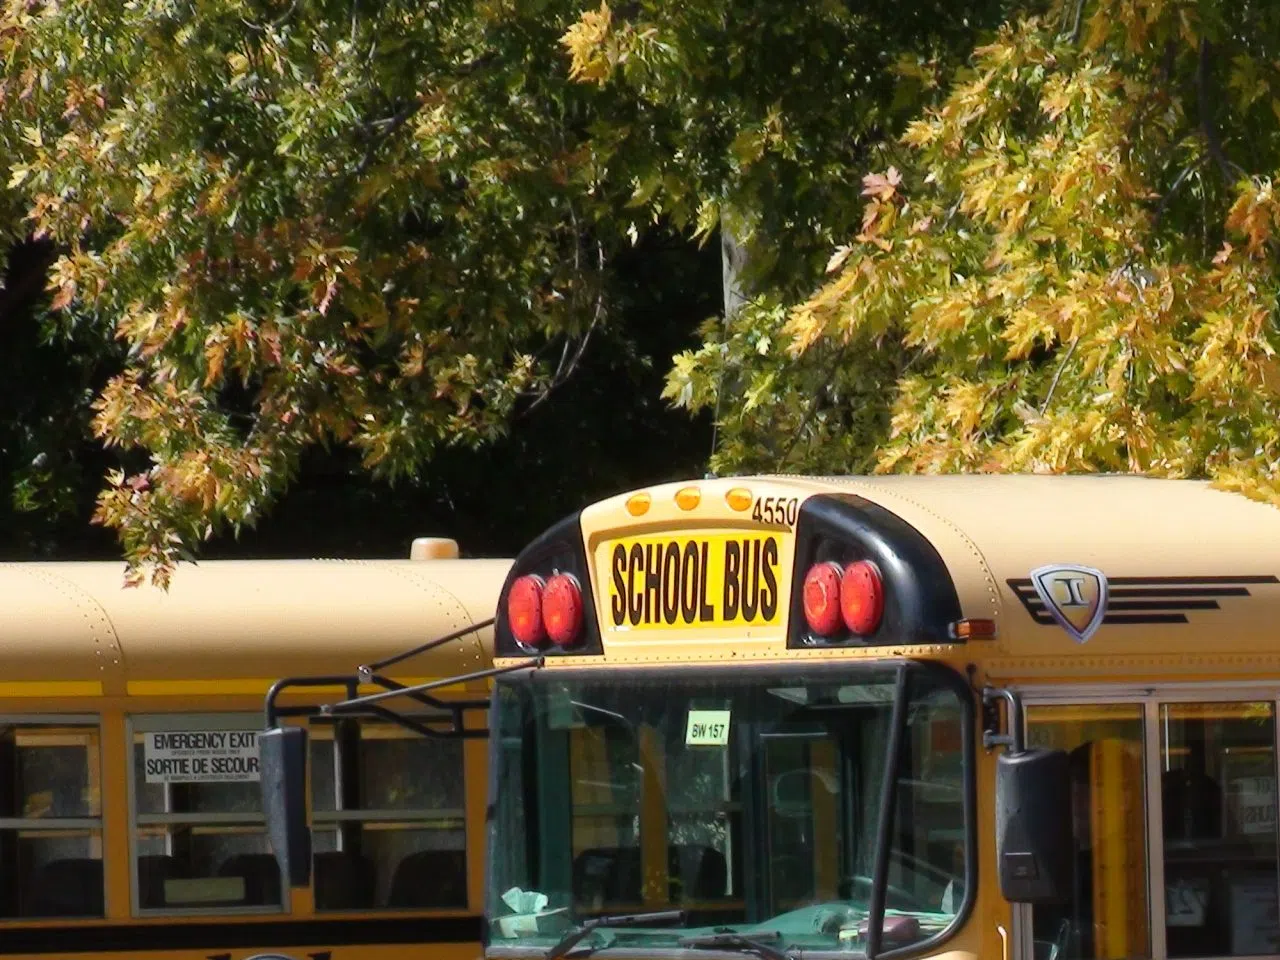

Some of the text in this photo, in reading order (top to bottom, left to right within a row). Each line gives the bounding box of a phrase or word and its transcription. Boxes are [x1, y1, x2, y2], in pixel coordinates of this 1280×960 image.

[752, 497, 798, 527] 4550
[612, 537, 778, 626] SCHOOL BUS
[709, 723, 725, 738] 157
[154, 732, 256, 749] EMERGENCY EXIT
[147, 758, 189, 775] SORTIE
[192, 757, 209, 774] DE
